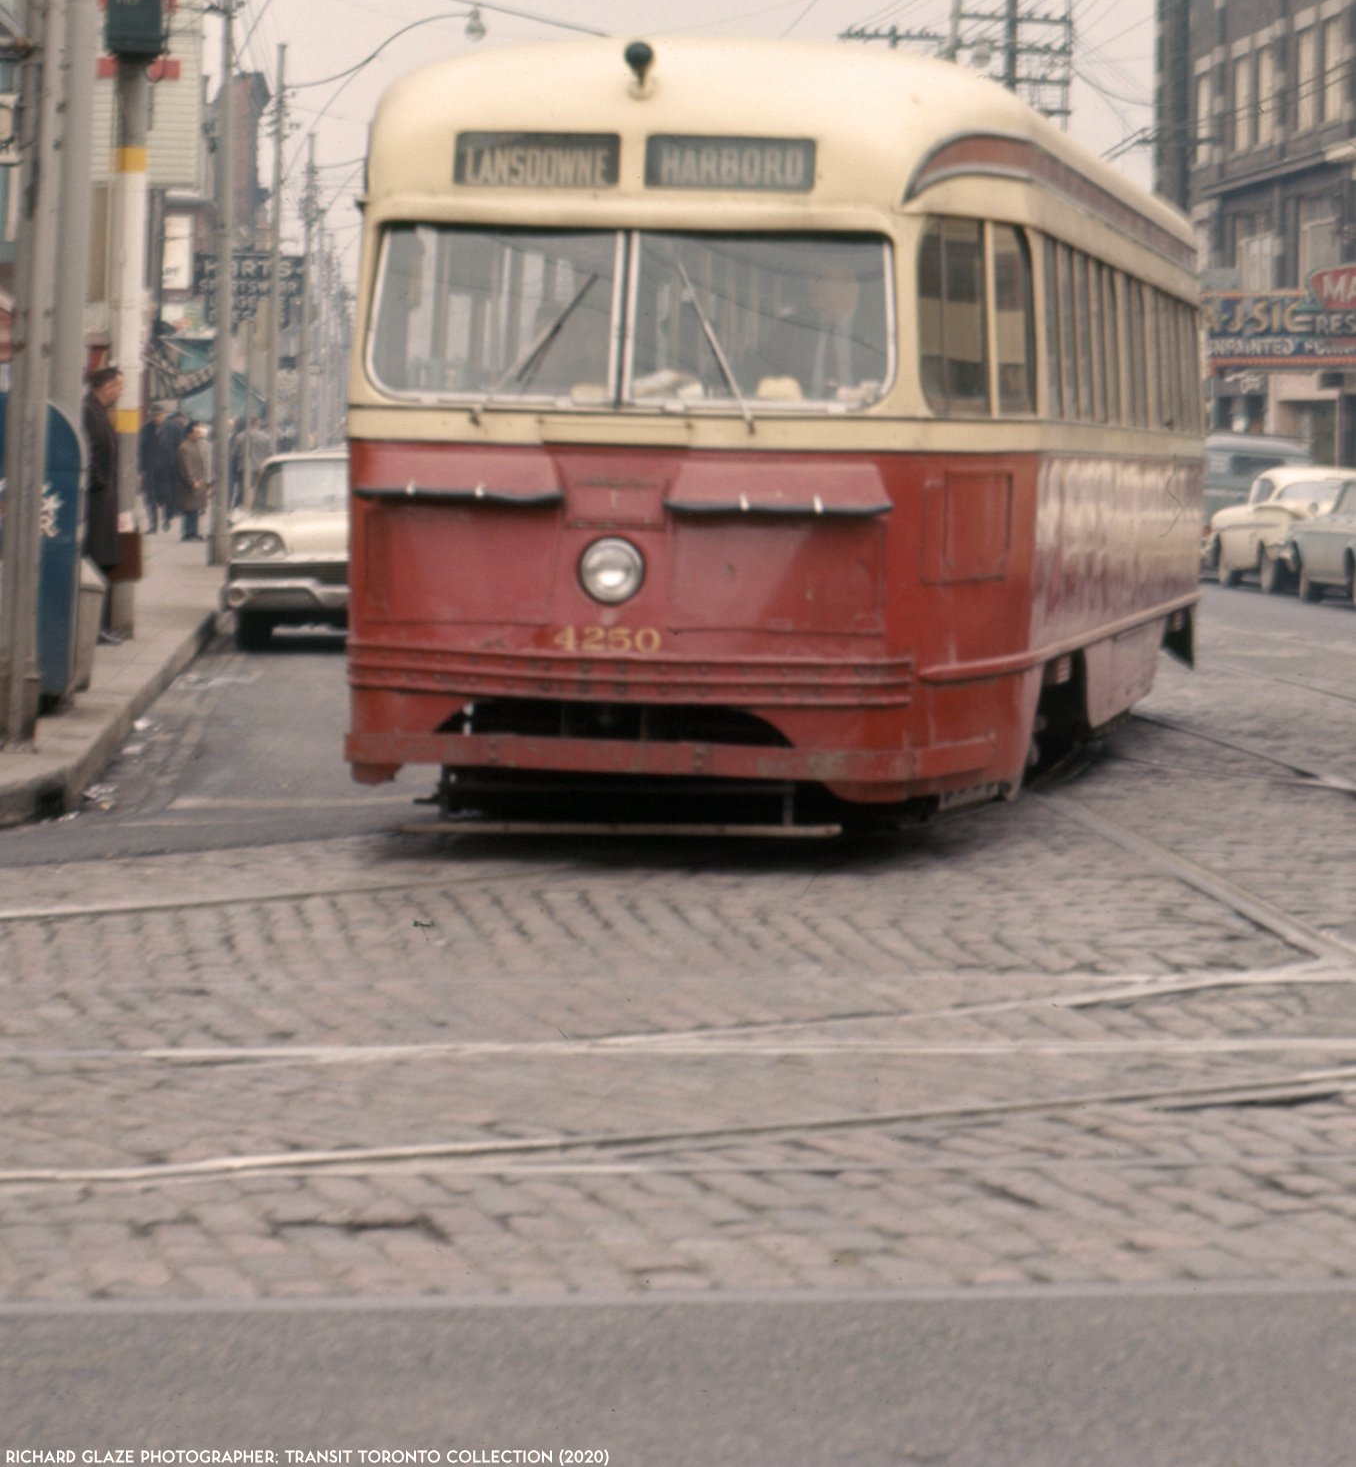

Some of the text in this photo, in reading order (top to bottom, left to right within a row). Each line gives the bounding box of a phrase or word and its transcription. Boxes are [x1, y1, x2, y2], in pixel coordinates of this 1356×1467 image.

[464, 145, 610, 186] LANSDOWNE
[659, 148, 805, 189] HARBORD
[553, 625, 662, 654] 4250
